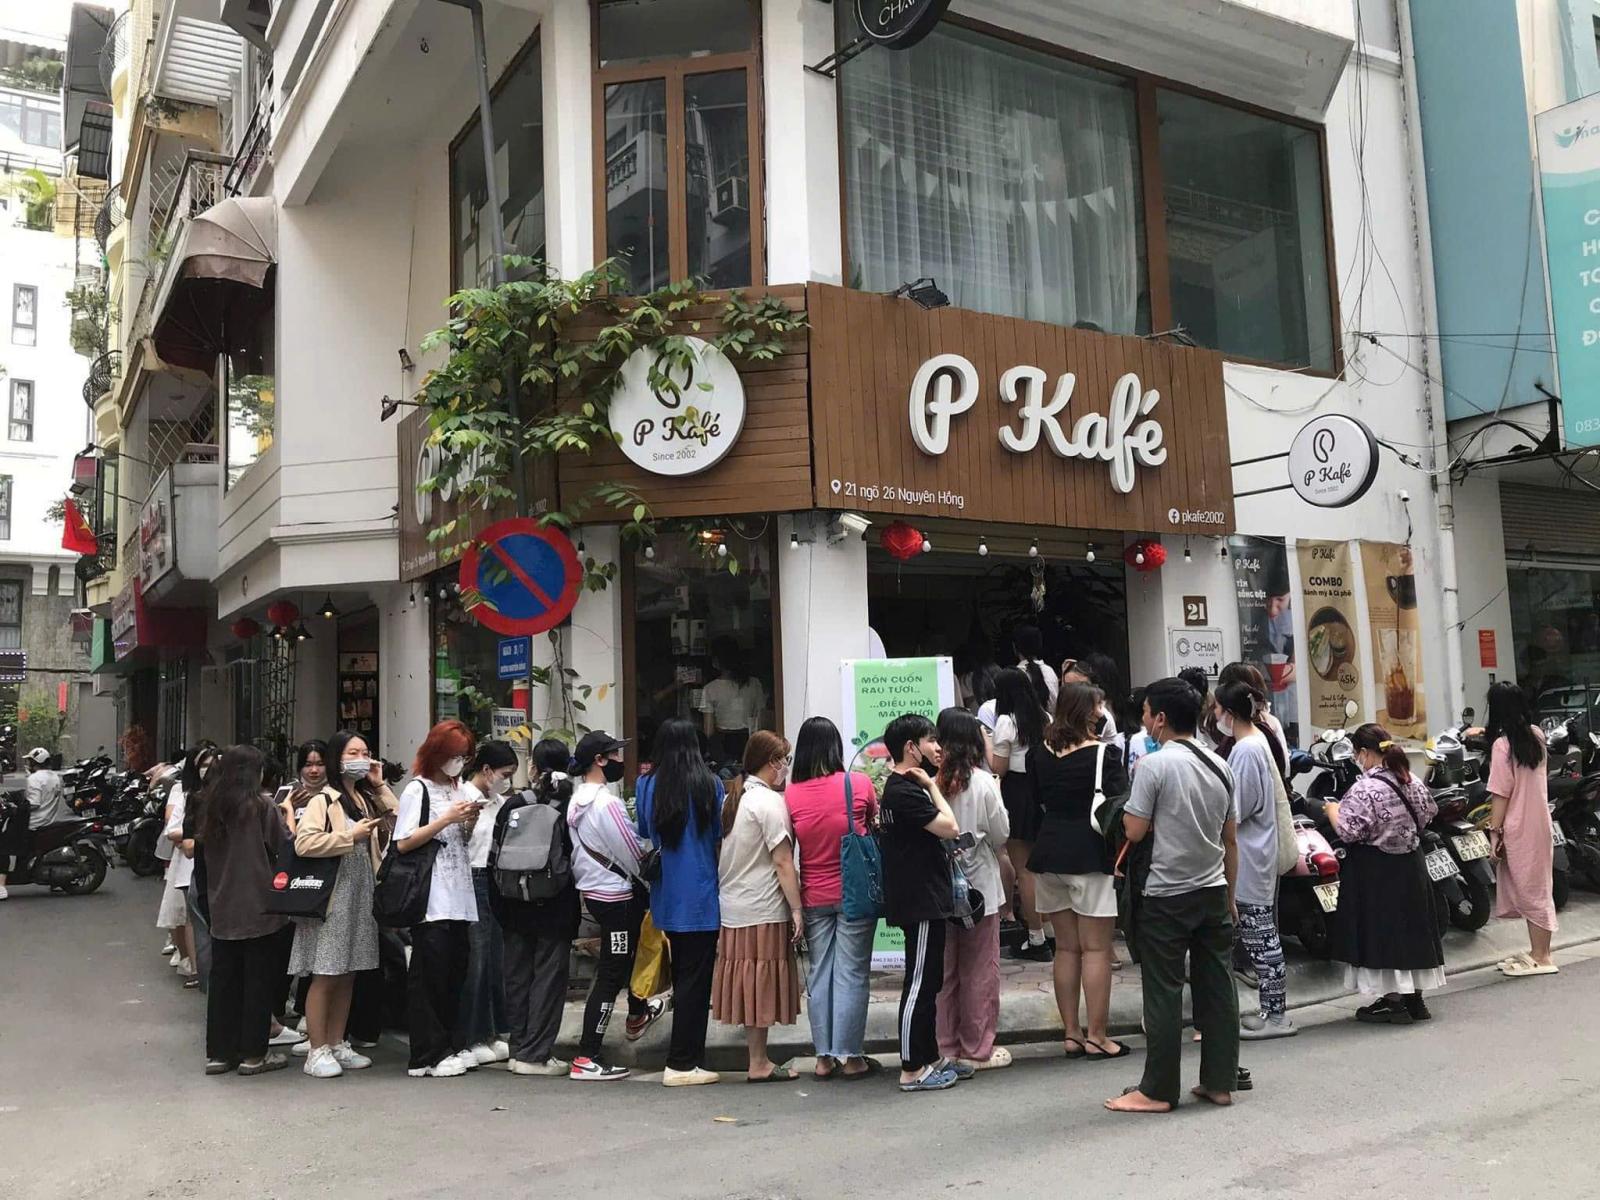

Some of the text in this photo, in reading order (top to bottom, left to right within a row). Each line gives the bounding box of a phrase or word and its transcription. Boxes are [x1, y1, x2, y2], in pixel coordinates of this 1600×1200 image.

[633, 410, 721, 447] P Kafé
[909, 353, 1168, 494] P Kafé
[652, 449, 697, 461] Since 2002
[1304, 462, 1352, 487] P Kafé
[844, 481, 965, 509] 21 ngõ 26 Nguyên Hồng
[1181, 509, 1226, 525] pkafe2002
[1308, 576, 1343, 587] COMBO
[1187, 603, 1206, 620] 21
[1193, 641, 1220, 653] CHAM
[613, 933, 626, 942] 19
